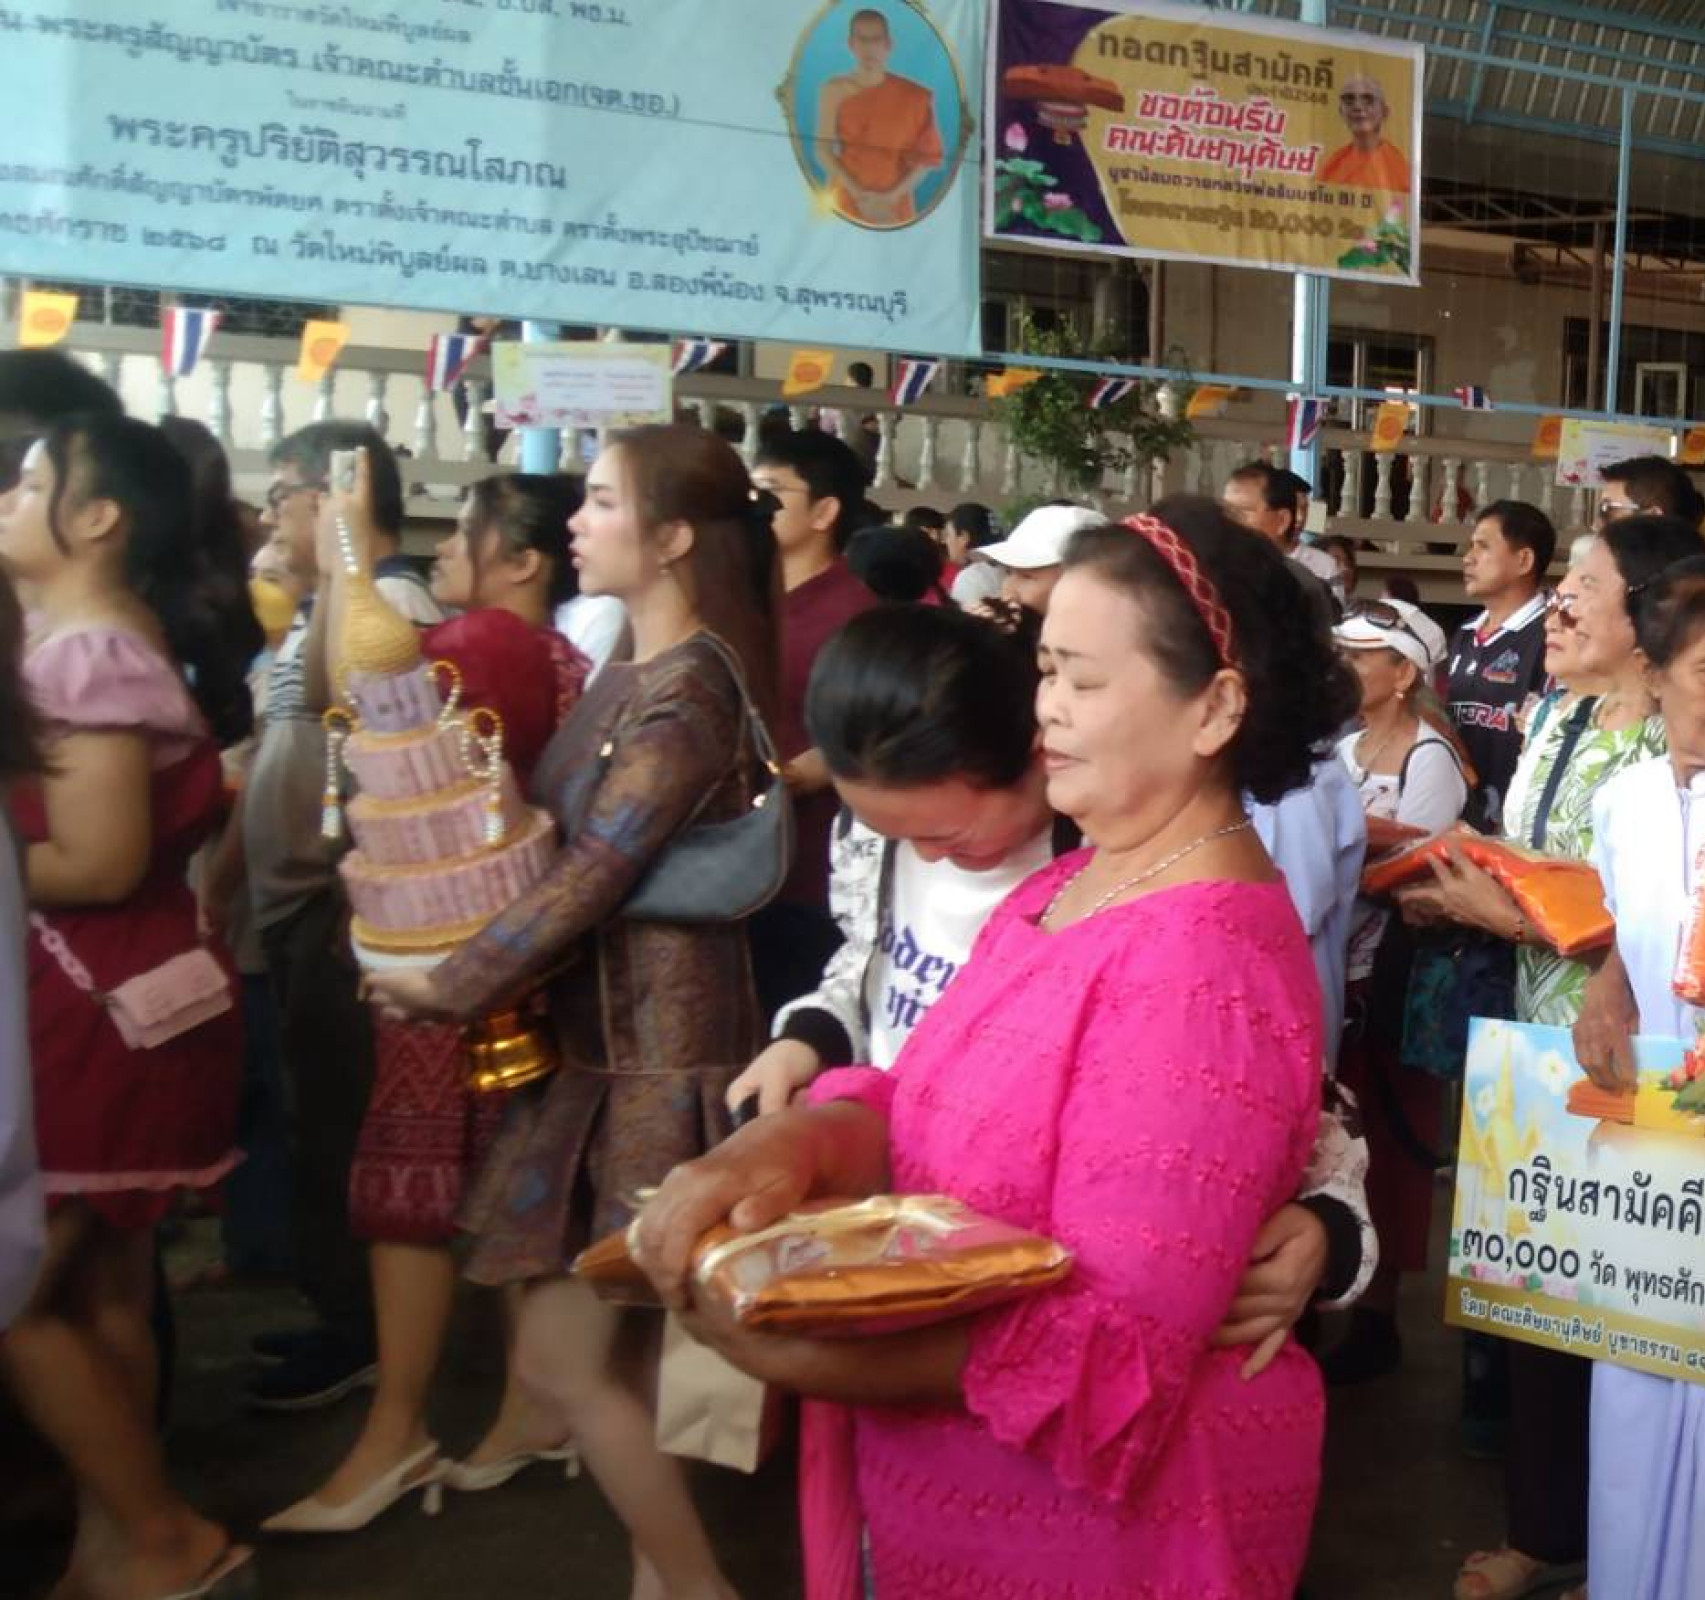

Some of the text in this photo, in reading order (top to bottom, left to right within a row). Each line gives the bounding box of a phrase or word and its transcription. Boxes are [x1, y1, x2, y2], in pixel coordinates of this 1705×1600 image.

[1098, 33, 1334, 89] ทอดกฐินสามัคคี
[1138, 87, 1286, 136] ขอต้อนรับ
[107, 113, 567, 188] พระครูปริยัติสุวรรณโสภณ
[1106, 124, 1320, 178] คณะศิษยานุศิษย์
[628, 266, 764, 301] อ.สองพี่น้อง
[775, 284, 908, 321] จ.สุพรรณบุรี
[1462, 1227, 1580, 1279] ๓๐,๐๐๐
[1590, 1250, 1617, 1287] วัด
[1461, 1288, 1488, 1318] โดย
[1490, 1303, 1604, 1345] คณะศิษยานุศิษย์
[1609, 1330, 1682, 1364] บูชาธรรม
